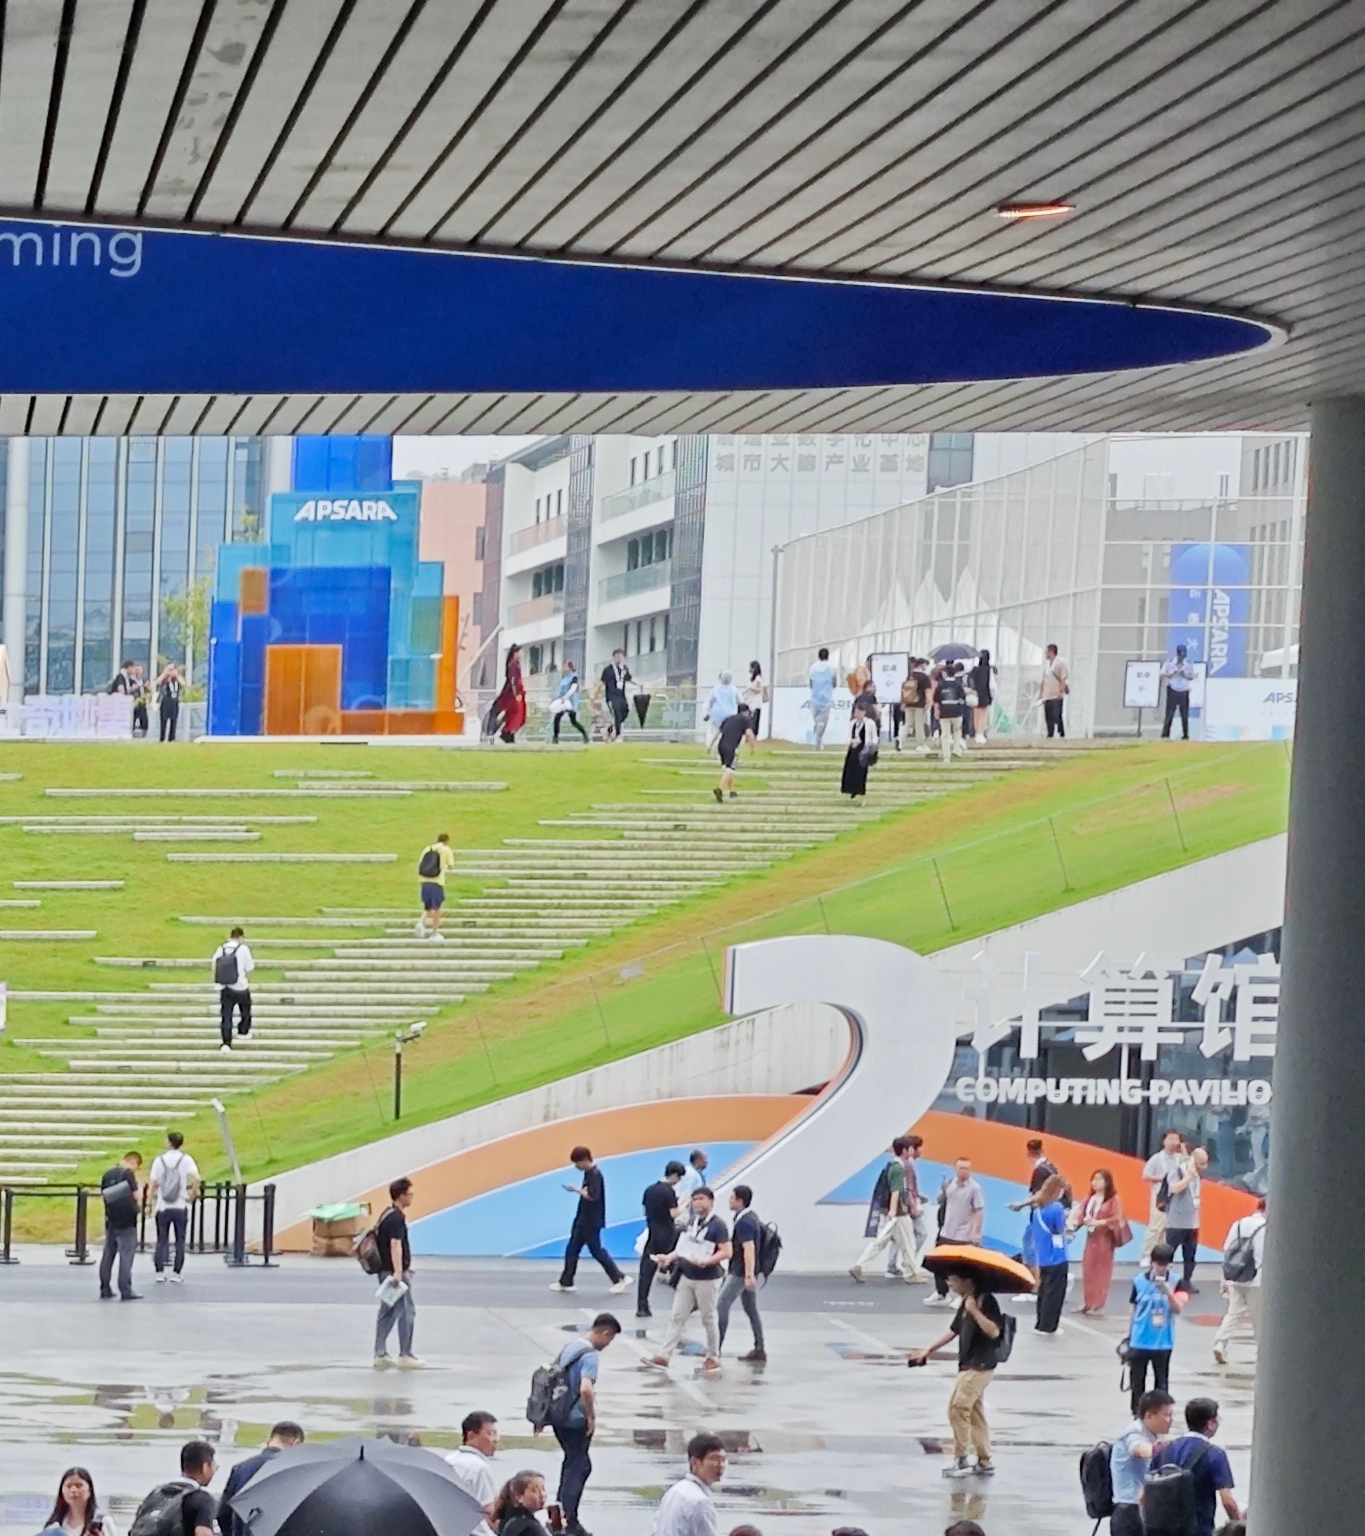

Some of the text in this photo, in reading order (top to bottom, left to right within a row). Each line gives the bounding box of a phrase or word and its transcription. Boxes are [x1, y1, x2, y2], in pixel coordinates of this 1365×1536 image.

[293, 499, 398, 522] APSARA
[1209, 588, 1232, 675] APSARA
[964, 950, 1281, 1062] 计算馆
[955, 1077, 1142, 1105] COMPUTING
